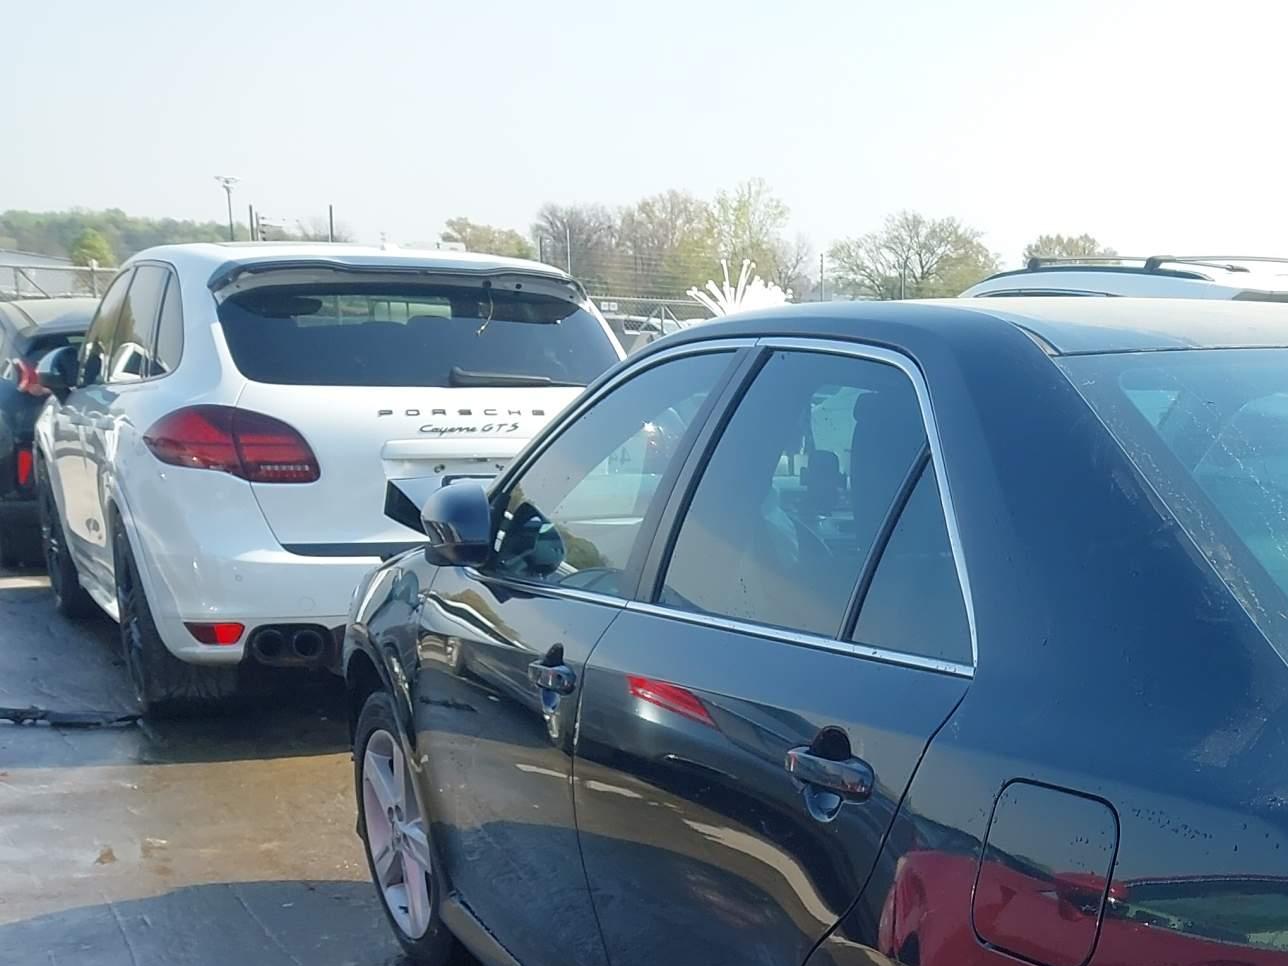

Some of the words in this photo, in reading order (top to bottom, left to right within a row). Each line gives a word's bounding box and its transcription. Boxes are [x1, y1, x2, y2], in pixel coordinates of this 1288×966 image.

[378, 408, 545, 418] PORSCHE
[418, 423, 478, 437] Cayenne
[481, 422, 520, 433] GTS
